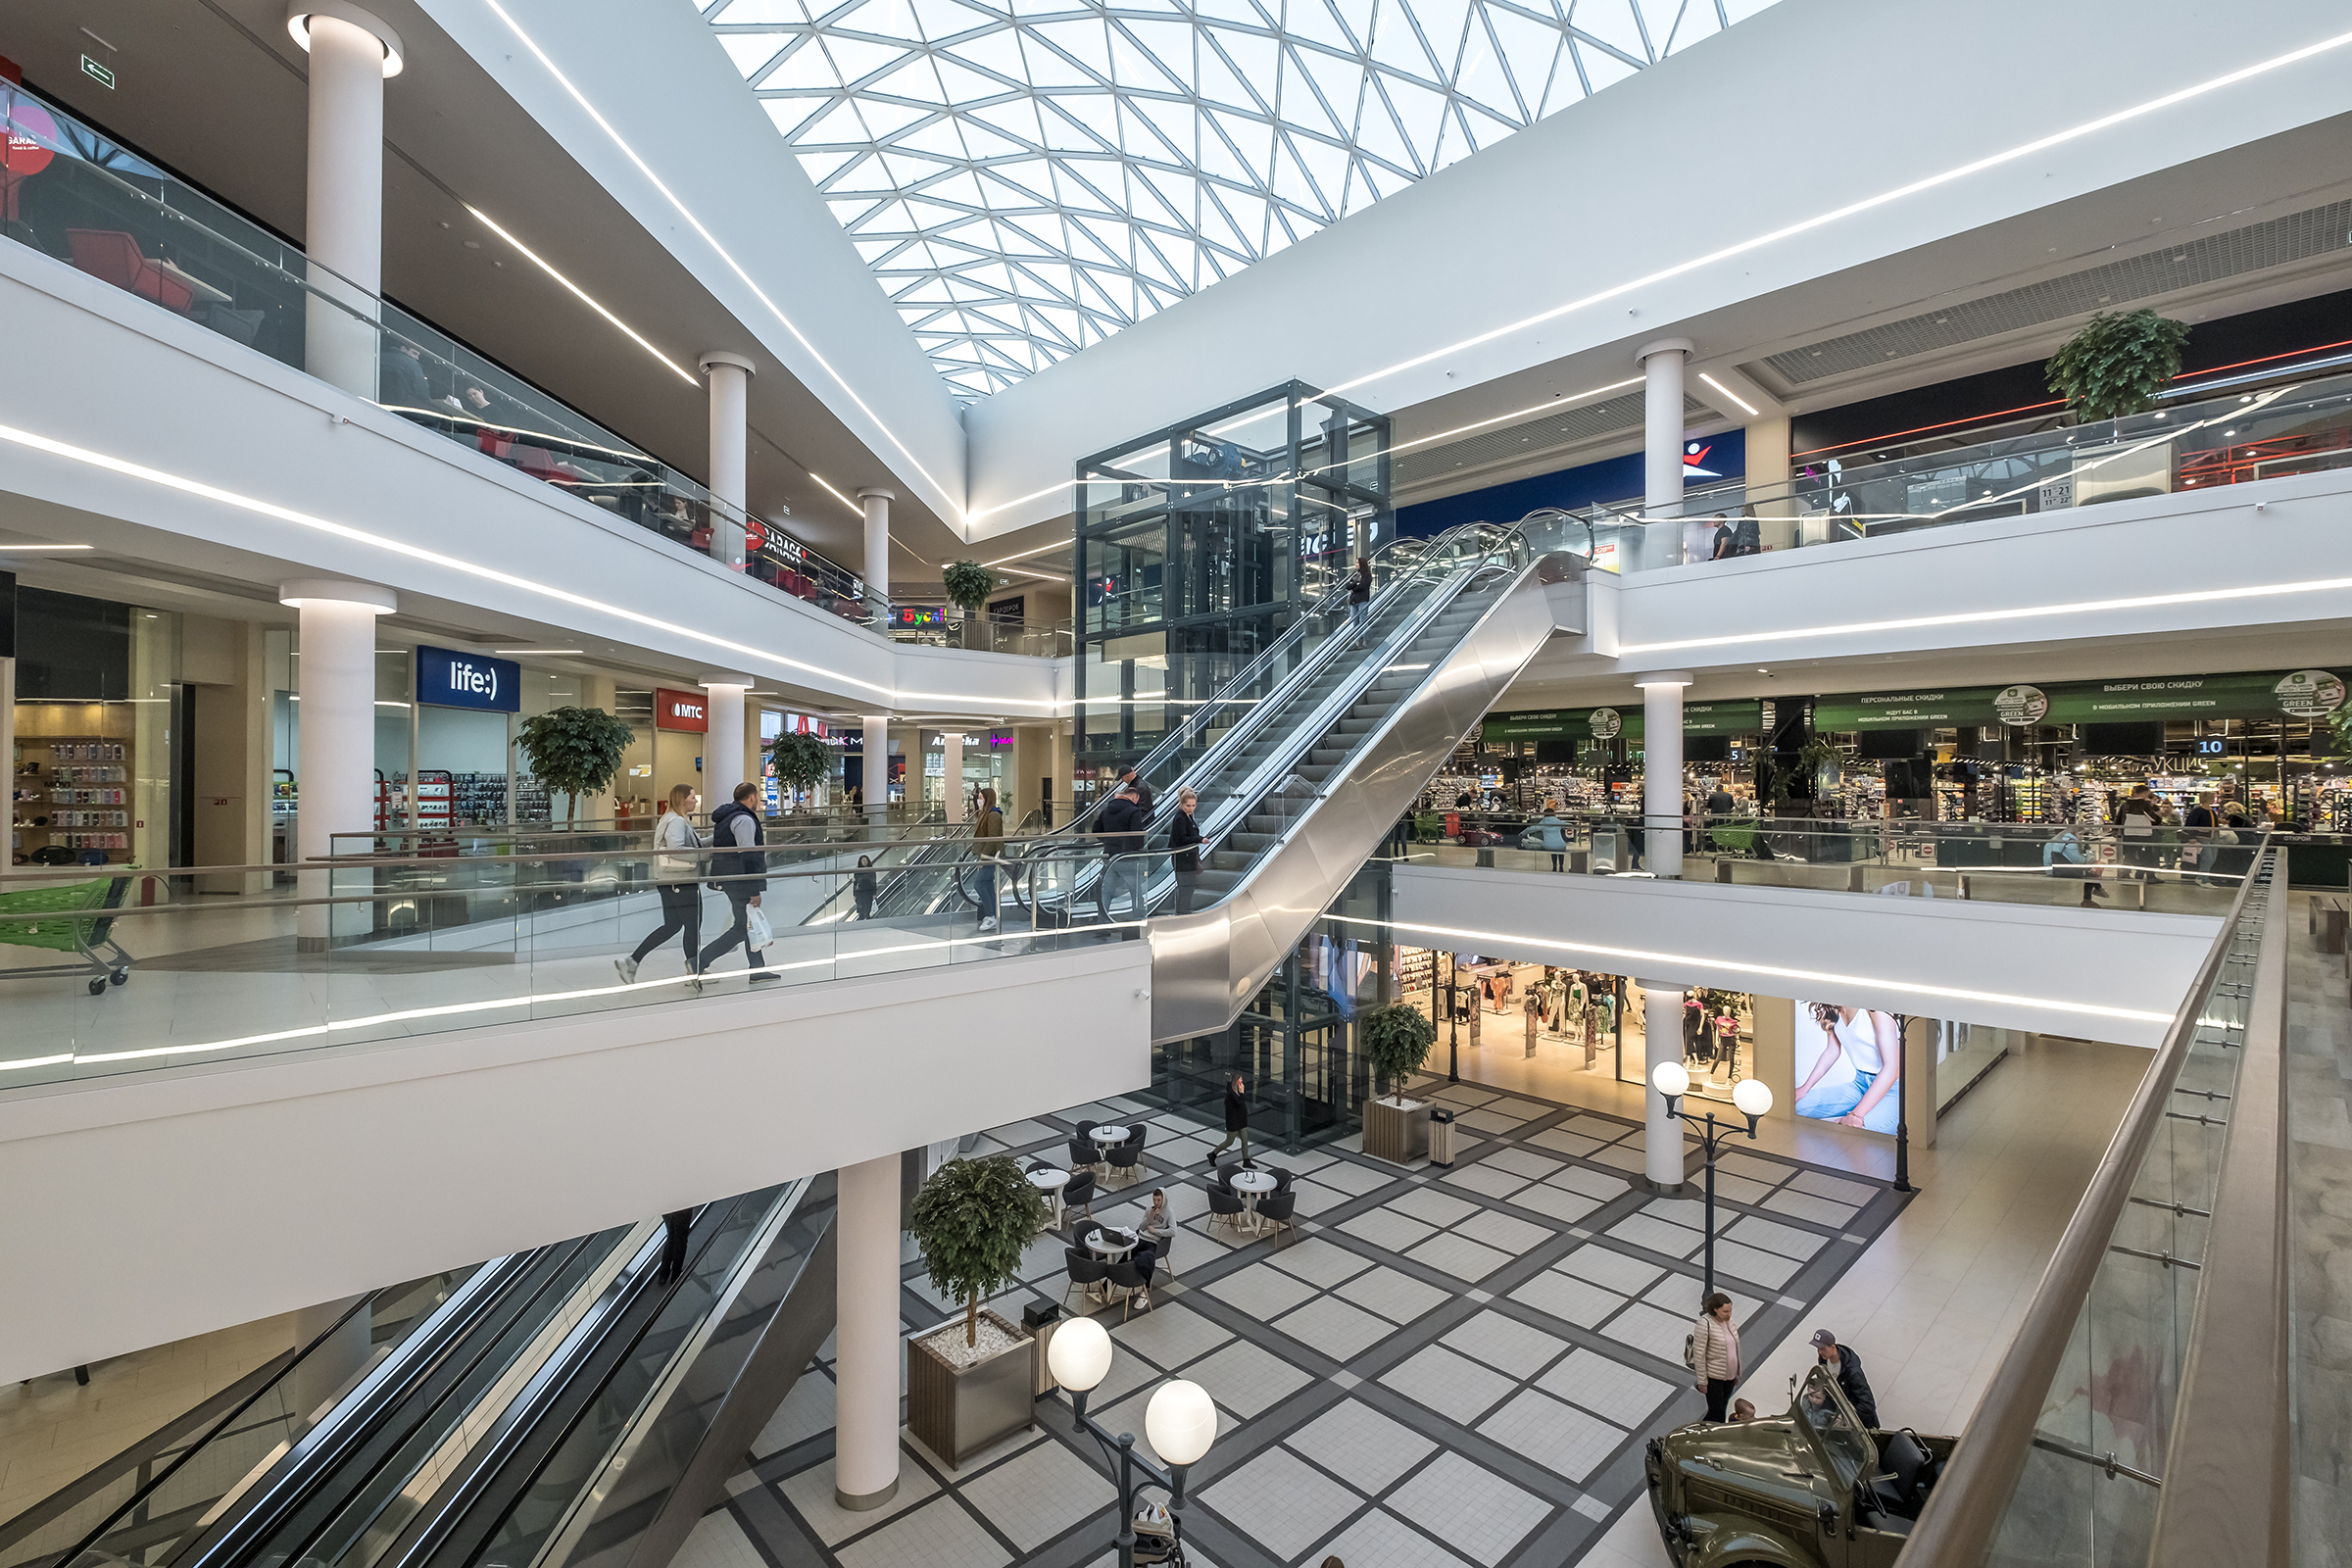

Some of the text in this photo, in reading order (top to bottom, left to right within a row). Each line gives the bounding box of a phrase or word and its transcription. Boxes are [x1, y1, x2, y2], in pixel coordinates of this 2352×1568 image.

[451, 661, 498, 702] life:)
[2167, 680, 2204, 689] СКИДКУ
[1861, 695, 1914, 704] ПЕРСОНАЛЬНЫЕ
[2199, 740, 2223, 754] 10
